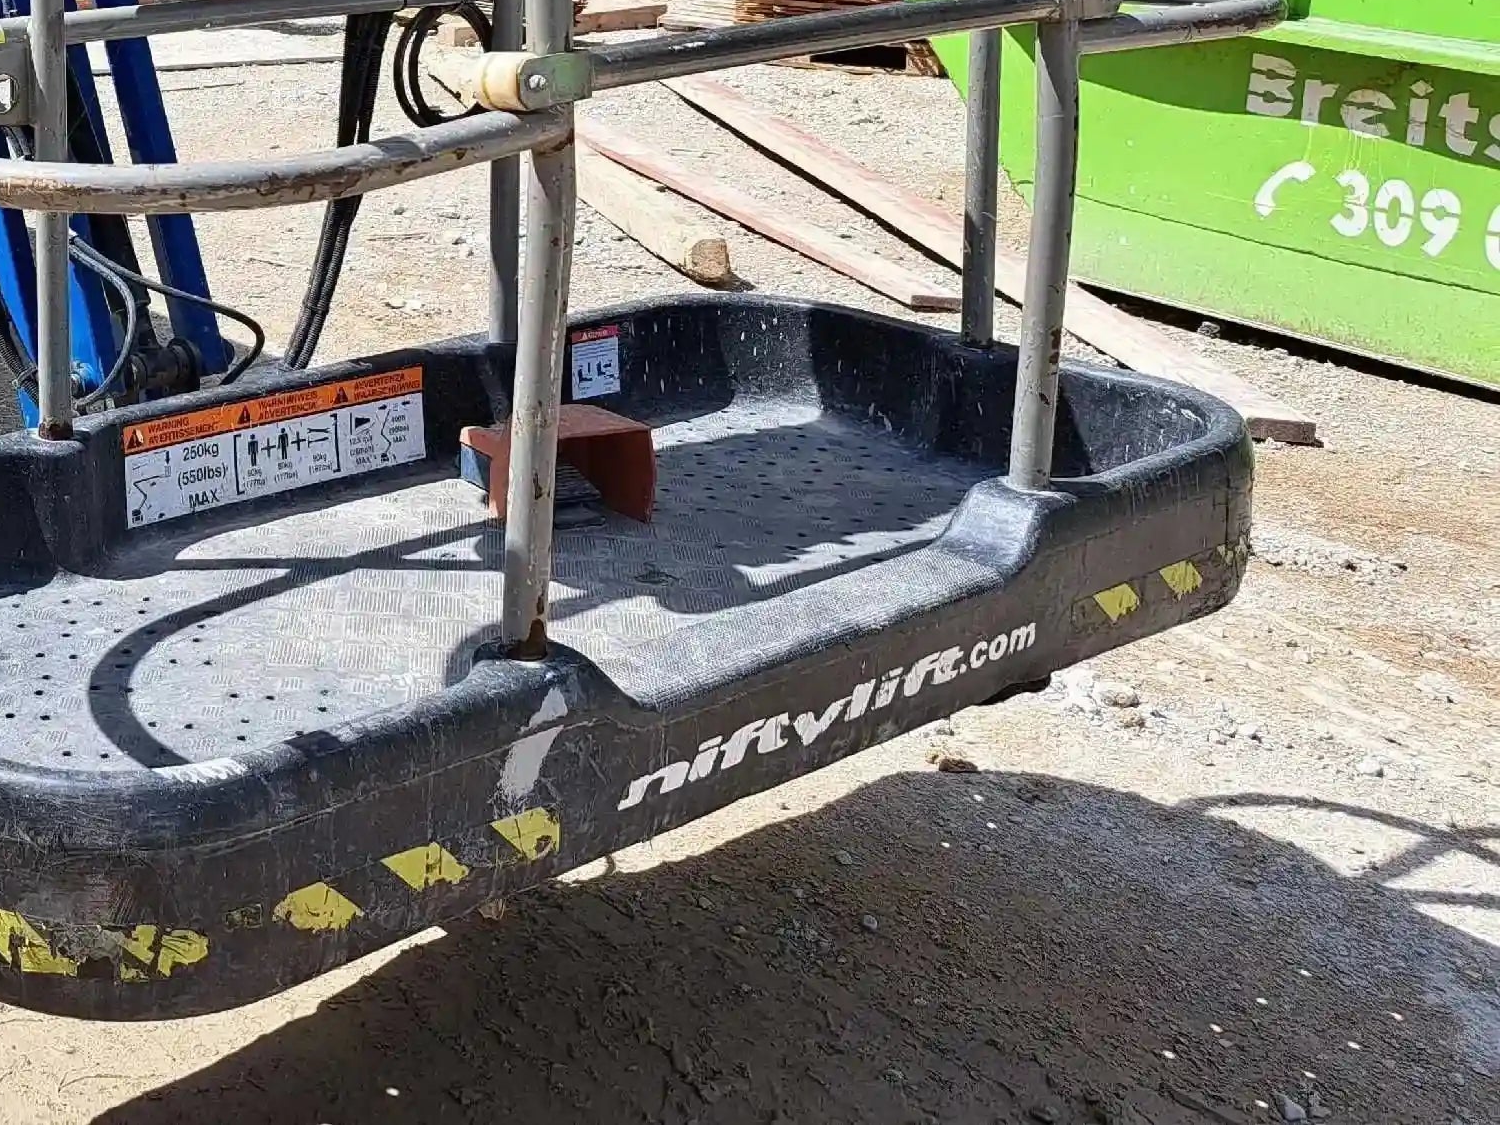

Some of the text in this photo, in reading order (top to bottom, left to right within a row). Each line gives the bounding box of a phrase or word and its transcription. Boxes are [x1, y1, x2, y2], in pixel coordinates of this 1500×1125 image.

[1329, 168, 1462, 258] 309
[149, 416, 190, 434] WARNING
[182, 441, 219, 462] 250kg
[178, 462, 227, 490] (550lbs)
[188, 488, 220, 509] MAX
